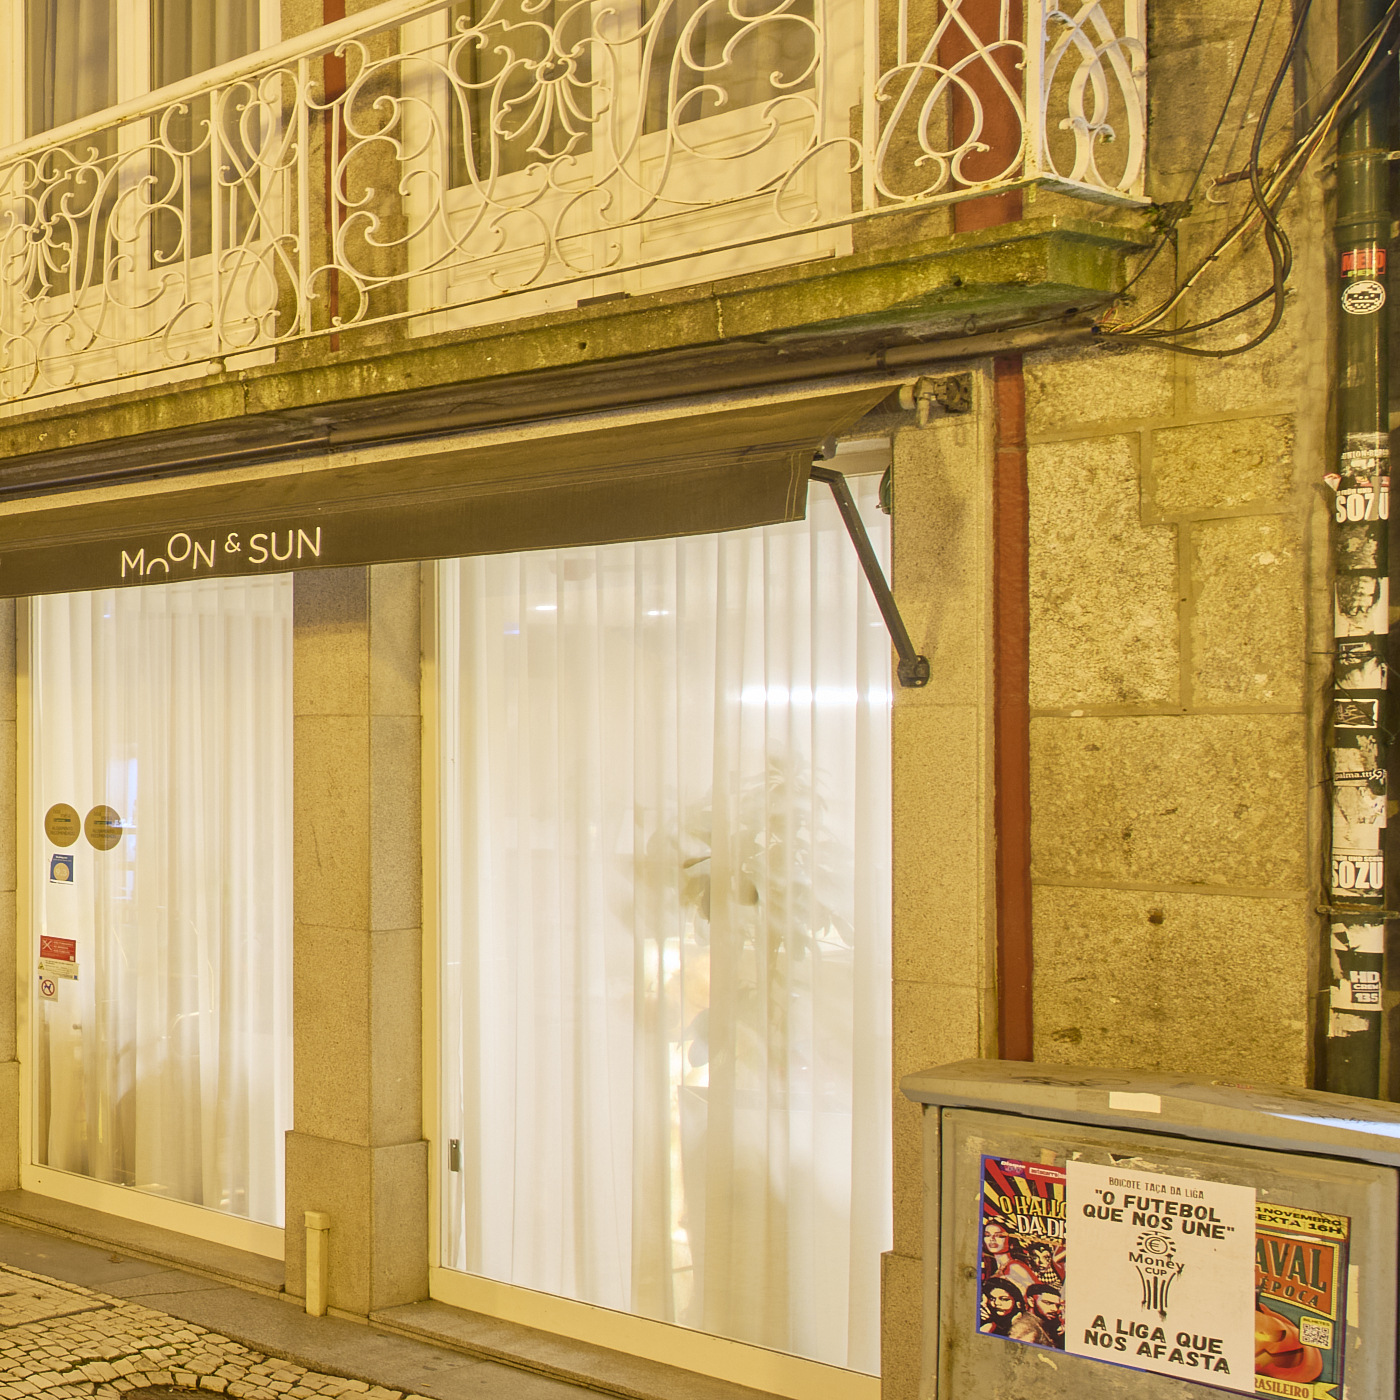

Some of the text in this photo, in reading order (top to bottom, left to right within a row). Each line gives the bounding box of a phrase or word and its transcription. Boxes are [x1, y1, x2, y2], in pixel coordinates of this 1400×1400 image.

[121, 526, 321, 577] MOON & SUN
[1349, 970, 1380, 983] HD
[1109, 1176, 1204, 1200] BOICOTE TAÇA DA LIGA
[999, 1195, 1013, 1214] O
[1123, 1194, 1221, 1223] FUTEBOL
[1016, 1214, 1067, 1239] DA DI
[1083, 1203, 1124, 1223] QUE
[1132, 1211, 1173, 1231] NOS
[1255, 1213, 1342, 1234] EXTA 16H
[1264, 1208, 1342, 1226] NOVEMBRO
[1128, 1252, 1185, 1272] Money
[1145, 1267, 1167, 1276] CUP
[1091, 1314, 1224, 1355] A LIGA QUE
[1084, 1329, 1231, 1375] NOS AFASTA
